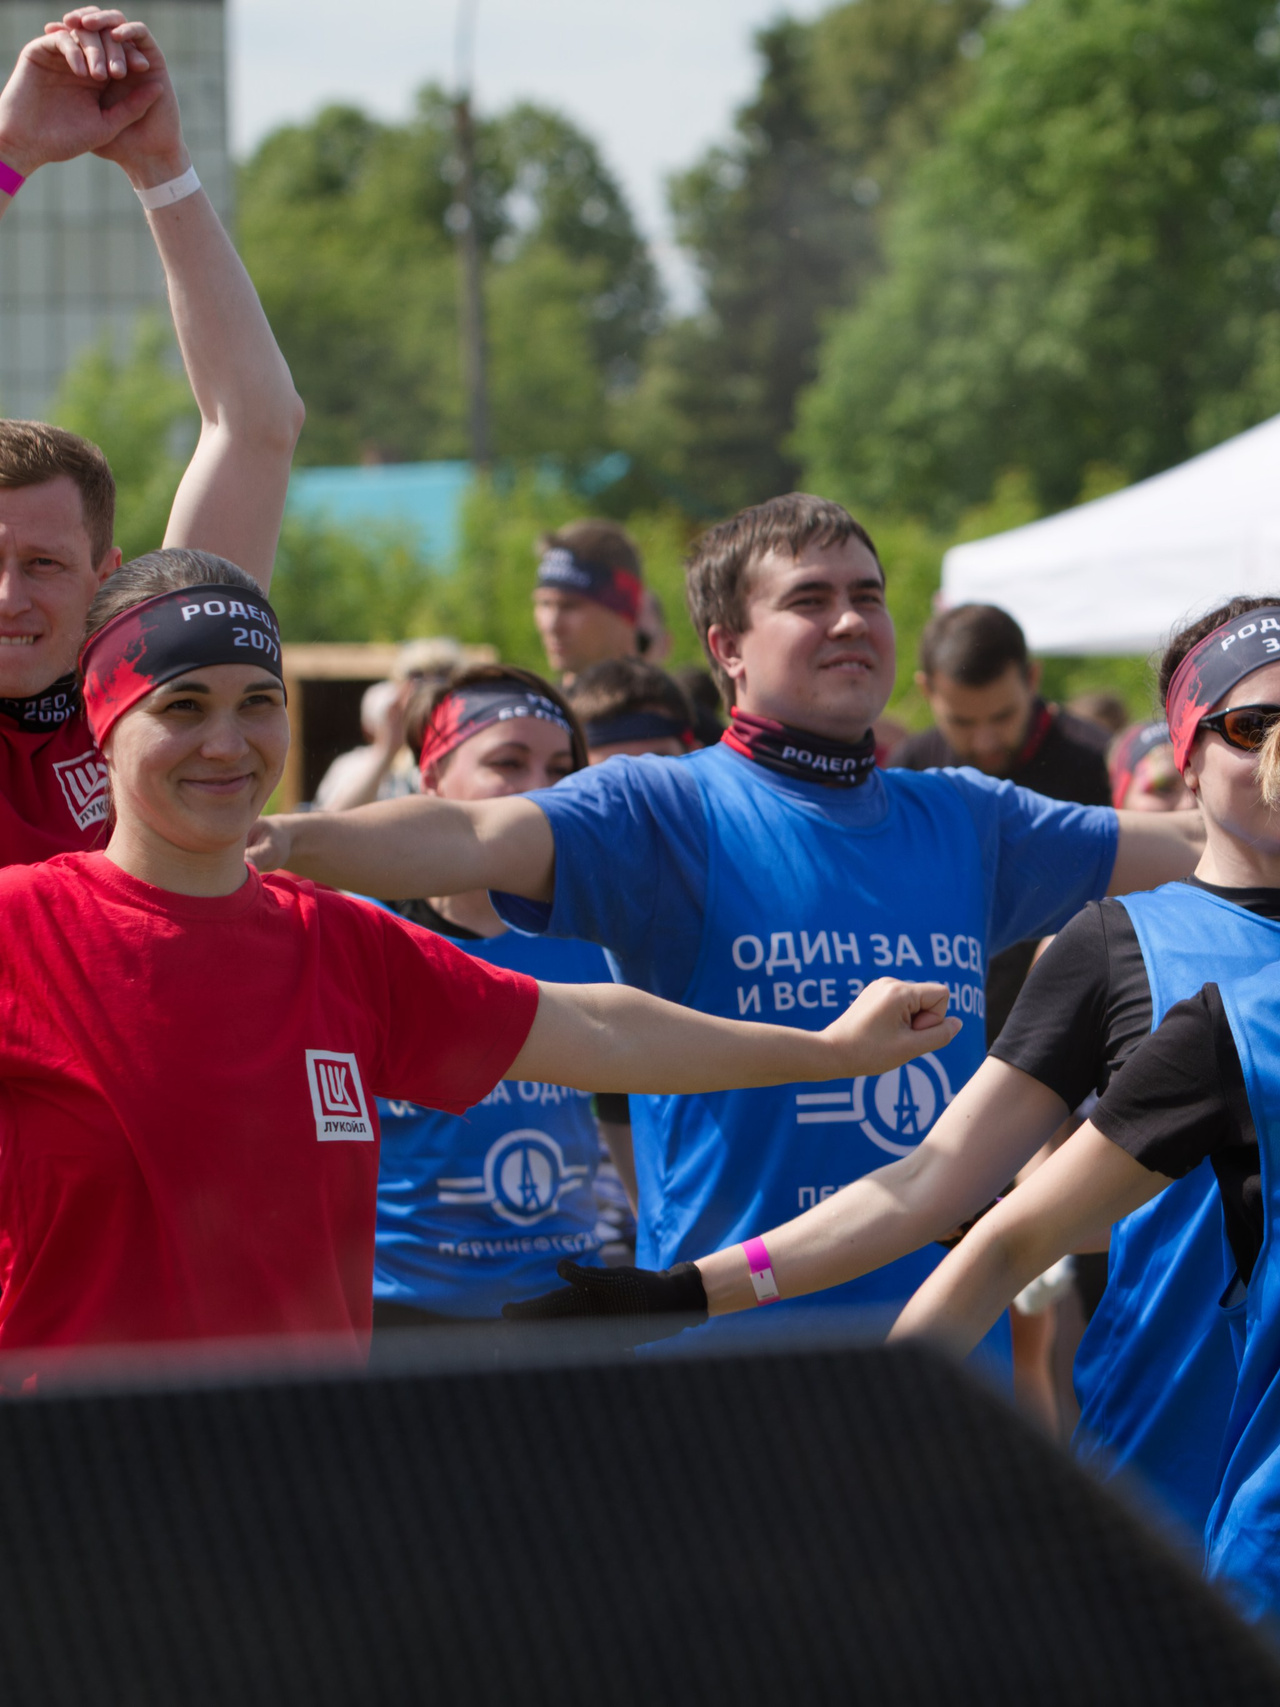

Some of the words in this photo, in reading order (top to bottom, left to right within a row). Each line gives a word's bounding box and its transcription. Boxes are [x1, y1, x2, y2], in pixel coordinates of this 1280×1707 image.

[181, 600, 272, 630] РОДЕО
[232, 626, 279, 662] 2077
[731, 930, 861, 976] ОДИН
[869, 933, 923, 967] ЗА
[737, 985, 762, 1015] И
[773, 979, 838, 1011] ВСЕ
[324, 1120, 367, 1133] ЛУКОЙЛ
